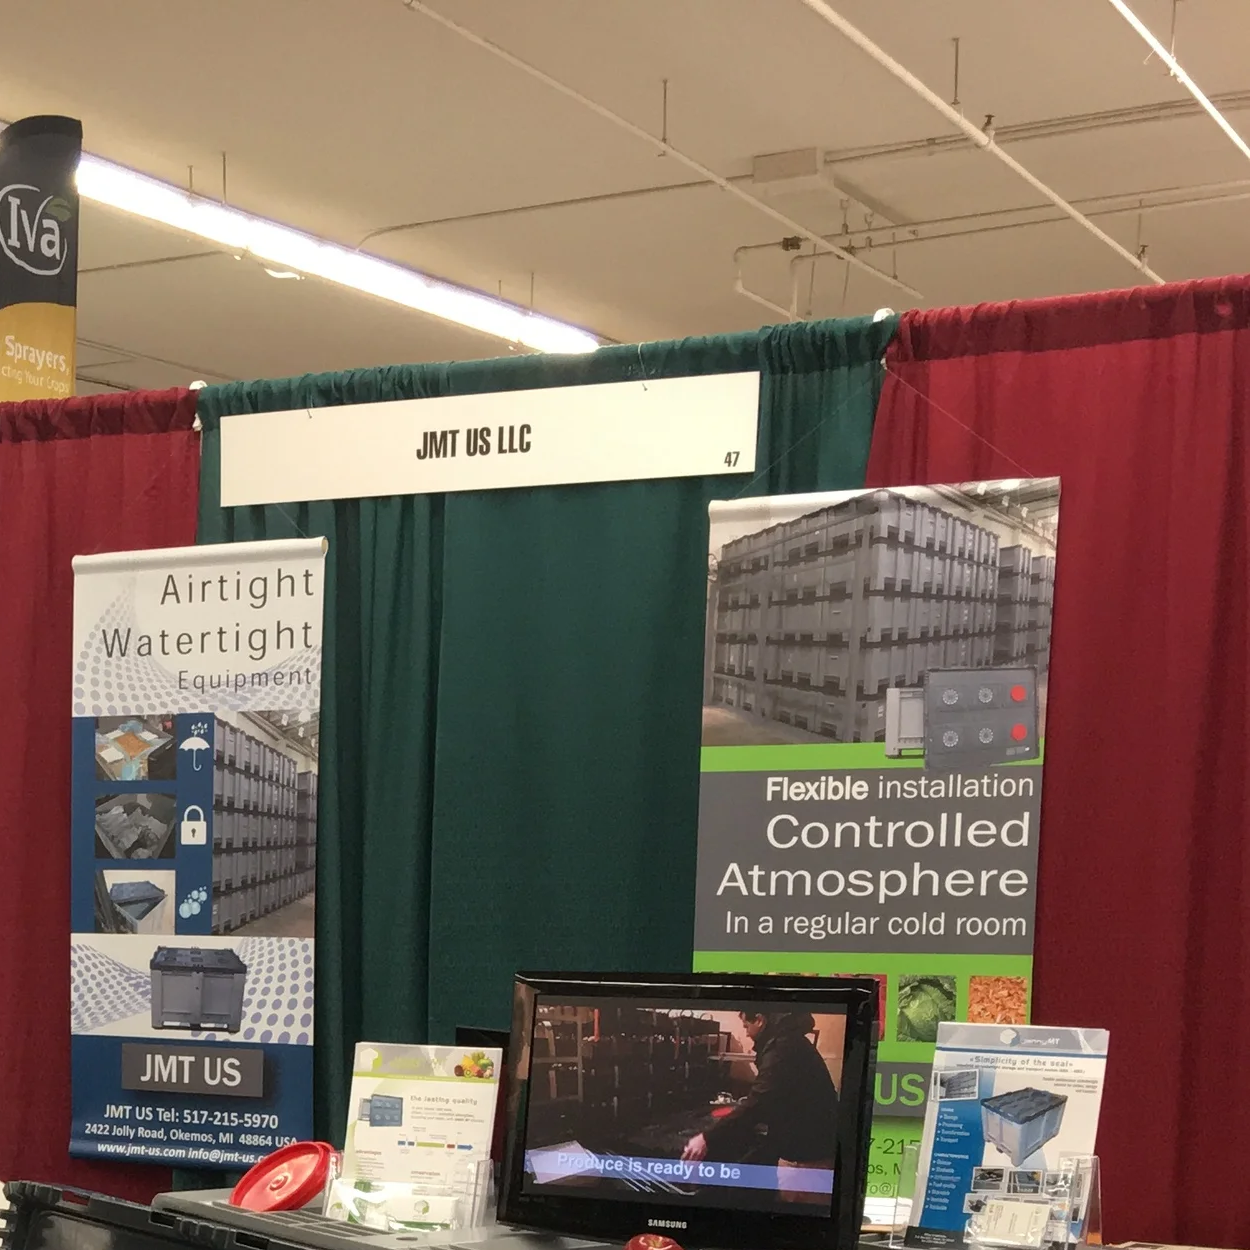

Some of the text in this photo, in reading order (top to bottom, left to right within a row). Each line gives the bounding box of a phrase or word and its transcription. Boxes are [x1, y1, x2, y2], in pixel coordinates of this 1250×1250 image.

[7, 195, 61, 260] Iva
[416, 424, 532, 460] JMT US LLC
[724, 451, 740, 468] 47
[160, 568, 314, 609] Airtight
[102, 620, 313, 661] Watertight
[178, 668, 312, 694] Equipment
[766, 773, 1034, 802] Flexible installation
[766, 811, 1030, 849] Controlled
[716, 861, 1029, 904] Atmosphere
[726, 910, 1027, 940] In a regular cold room
[140, 1053, 242, 1087] JMT US
[1033, 1058, 1048, 1068] the
[874, 1073, 925, 1107] US
[104, 1104, 279, 1129] JMT US Tel: 517-215-5970
[85, 1123, 110, 1136] 2422
[111, 1125, 136, 1140] Jolly
[138, 1127, 168, 1142] Road,
[169, 1128, 216, 1144] Okemos,
[218, 1132, 234, 1144] MI
[238, 1134, 272, 1148] 48864
[97, 1142, 264, 1164] www.jmt-us.com info@jmt-us.c
[557, 1152, 741, 1180] Produce is ready to be
[648, 1219, 687, 1230] SAMSUNG
